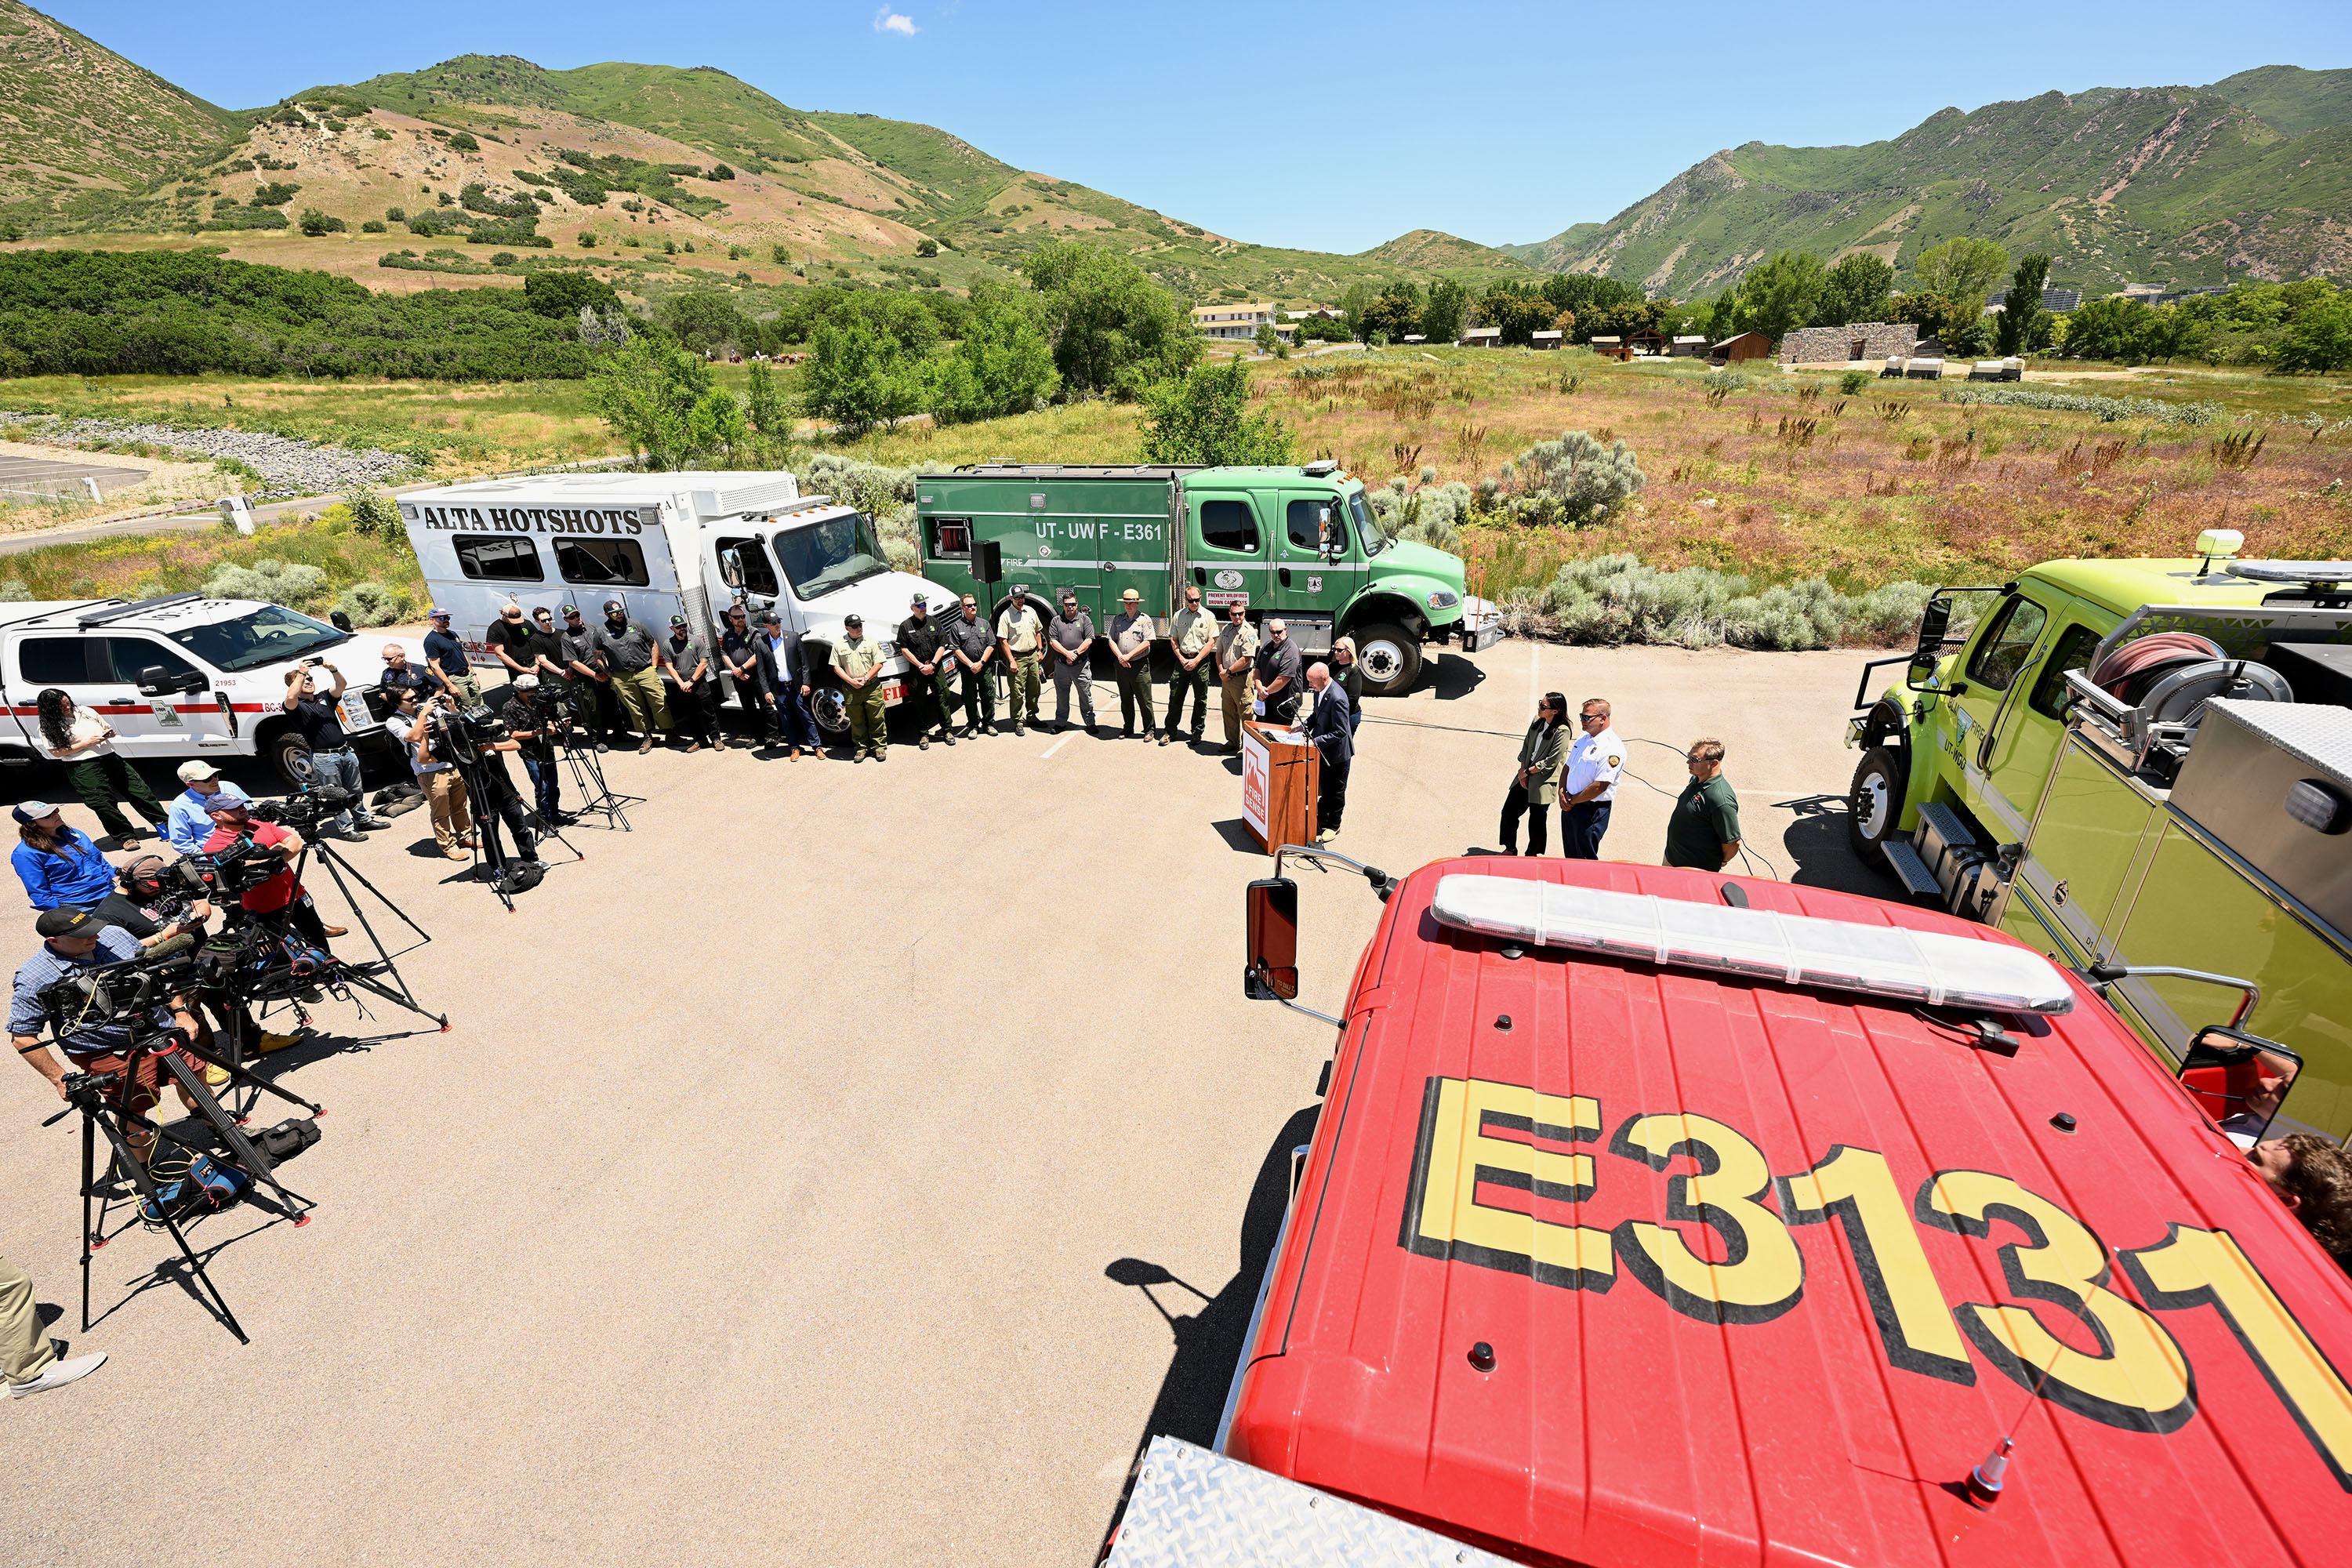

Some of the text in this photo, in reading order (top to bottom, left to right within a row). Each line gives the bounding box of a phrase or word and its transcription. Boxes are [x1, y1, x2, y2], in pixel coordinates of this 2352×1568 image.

[424, 507, 643, 535] ALTA HOTSHOTS
[1006, 558, 1023, 567] FIRE
[883, 683, 911, 701] FIR
[1970, 720, 1986, 741] FIRE
[1249, 785, 1261, 805] FIRE
[1246, 794, 1265, 820] SENSE
[2085, 936, 2094, 948] D1
[1397, 1076, 2352, 1494] E3131
